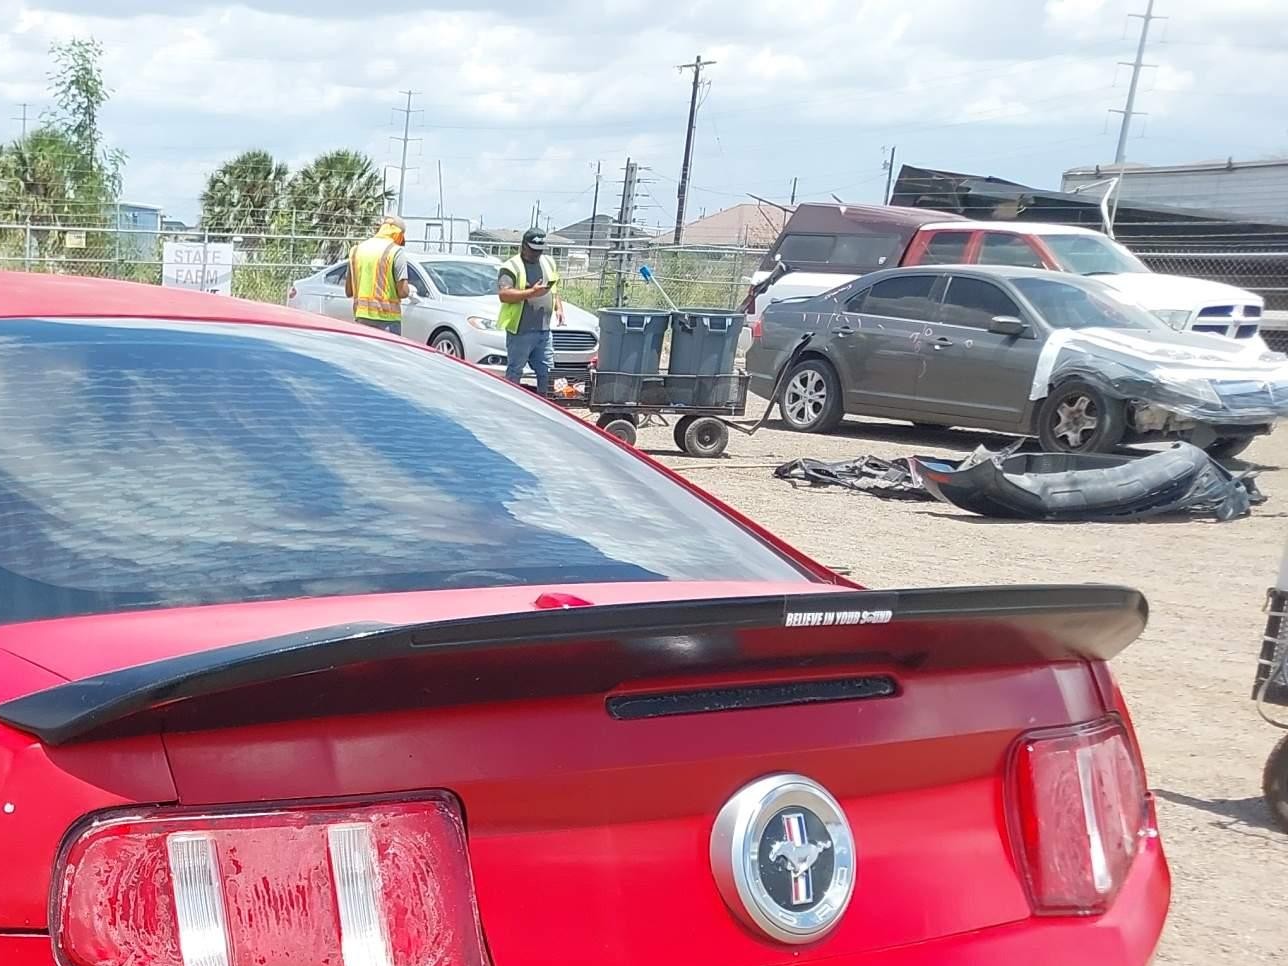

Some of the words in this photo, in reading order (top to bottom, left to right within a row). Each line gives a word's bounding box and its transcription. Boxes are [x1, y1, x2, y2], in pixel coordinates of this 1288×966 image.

[174, 250, 221, 264] STATE
[175, 269, 218, 285] FARM
[785, 612, 823, 627] BELIEVE
[822, 612, 835, 625] IN
[834, 611, 861, 625] YOUR
